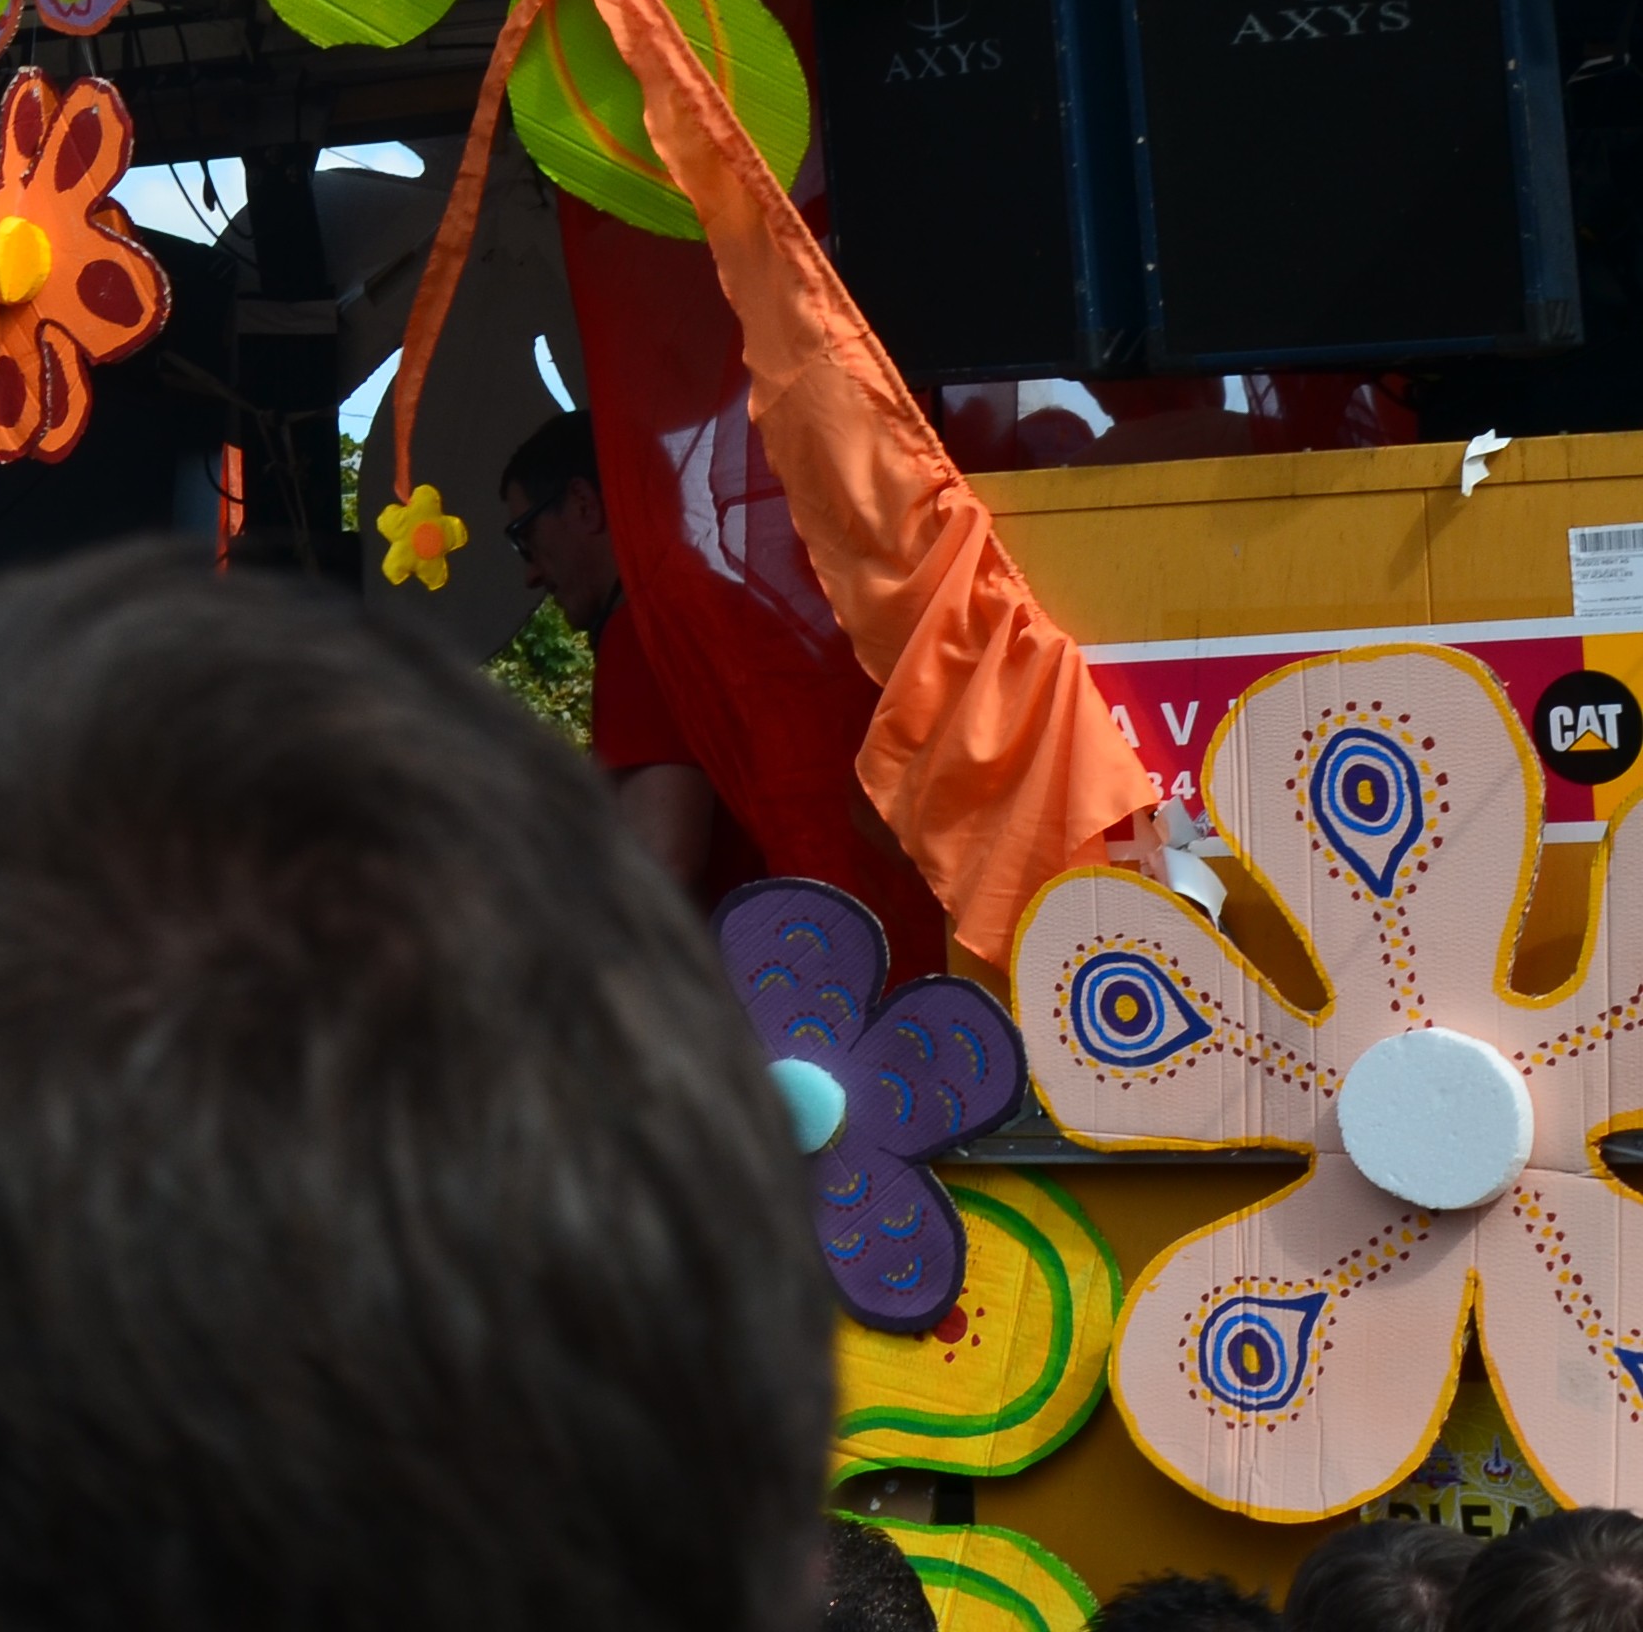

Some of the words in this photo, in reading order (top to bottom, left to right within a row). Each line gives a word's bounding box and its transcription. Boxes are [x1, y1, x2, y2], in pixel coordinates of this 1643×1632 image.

[1229, 0, 1411, 45] AXYS
[884, 38, 1003, 83] AXYS
[1549, 703, 1623, 752] CAT
